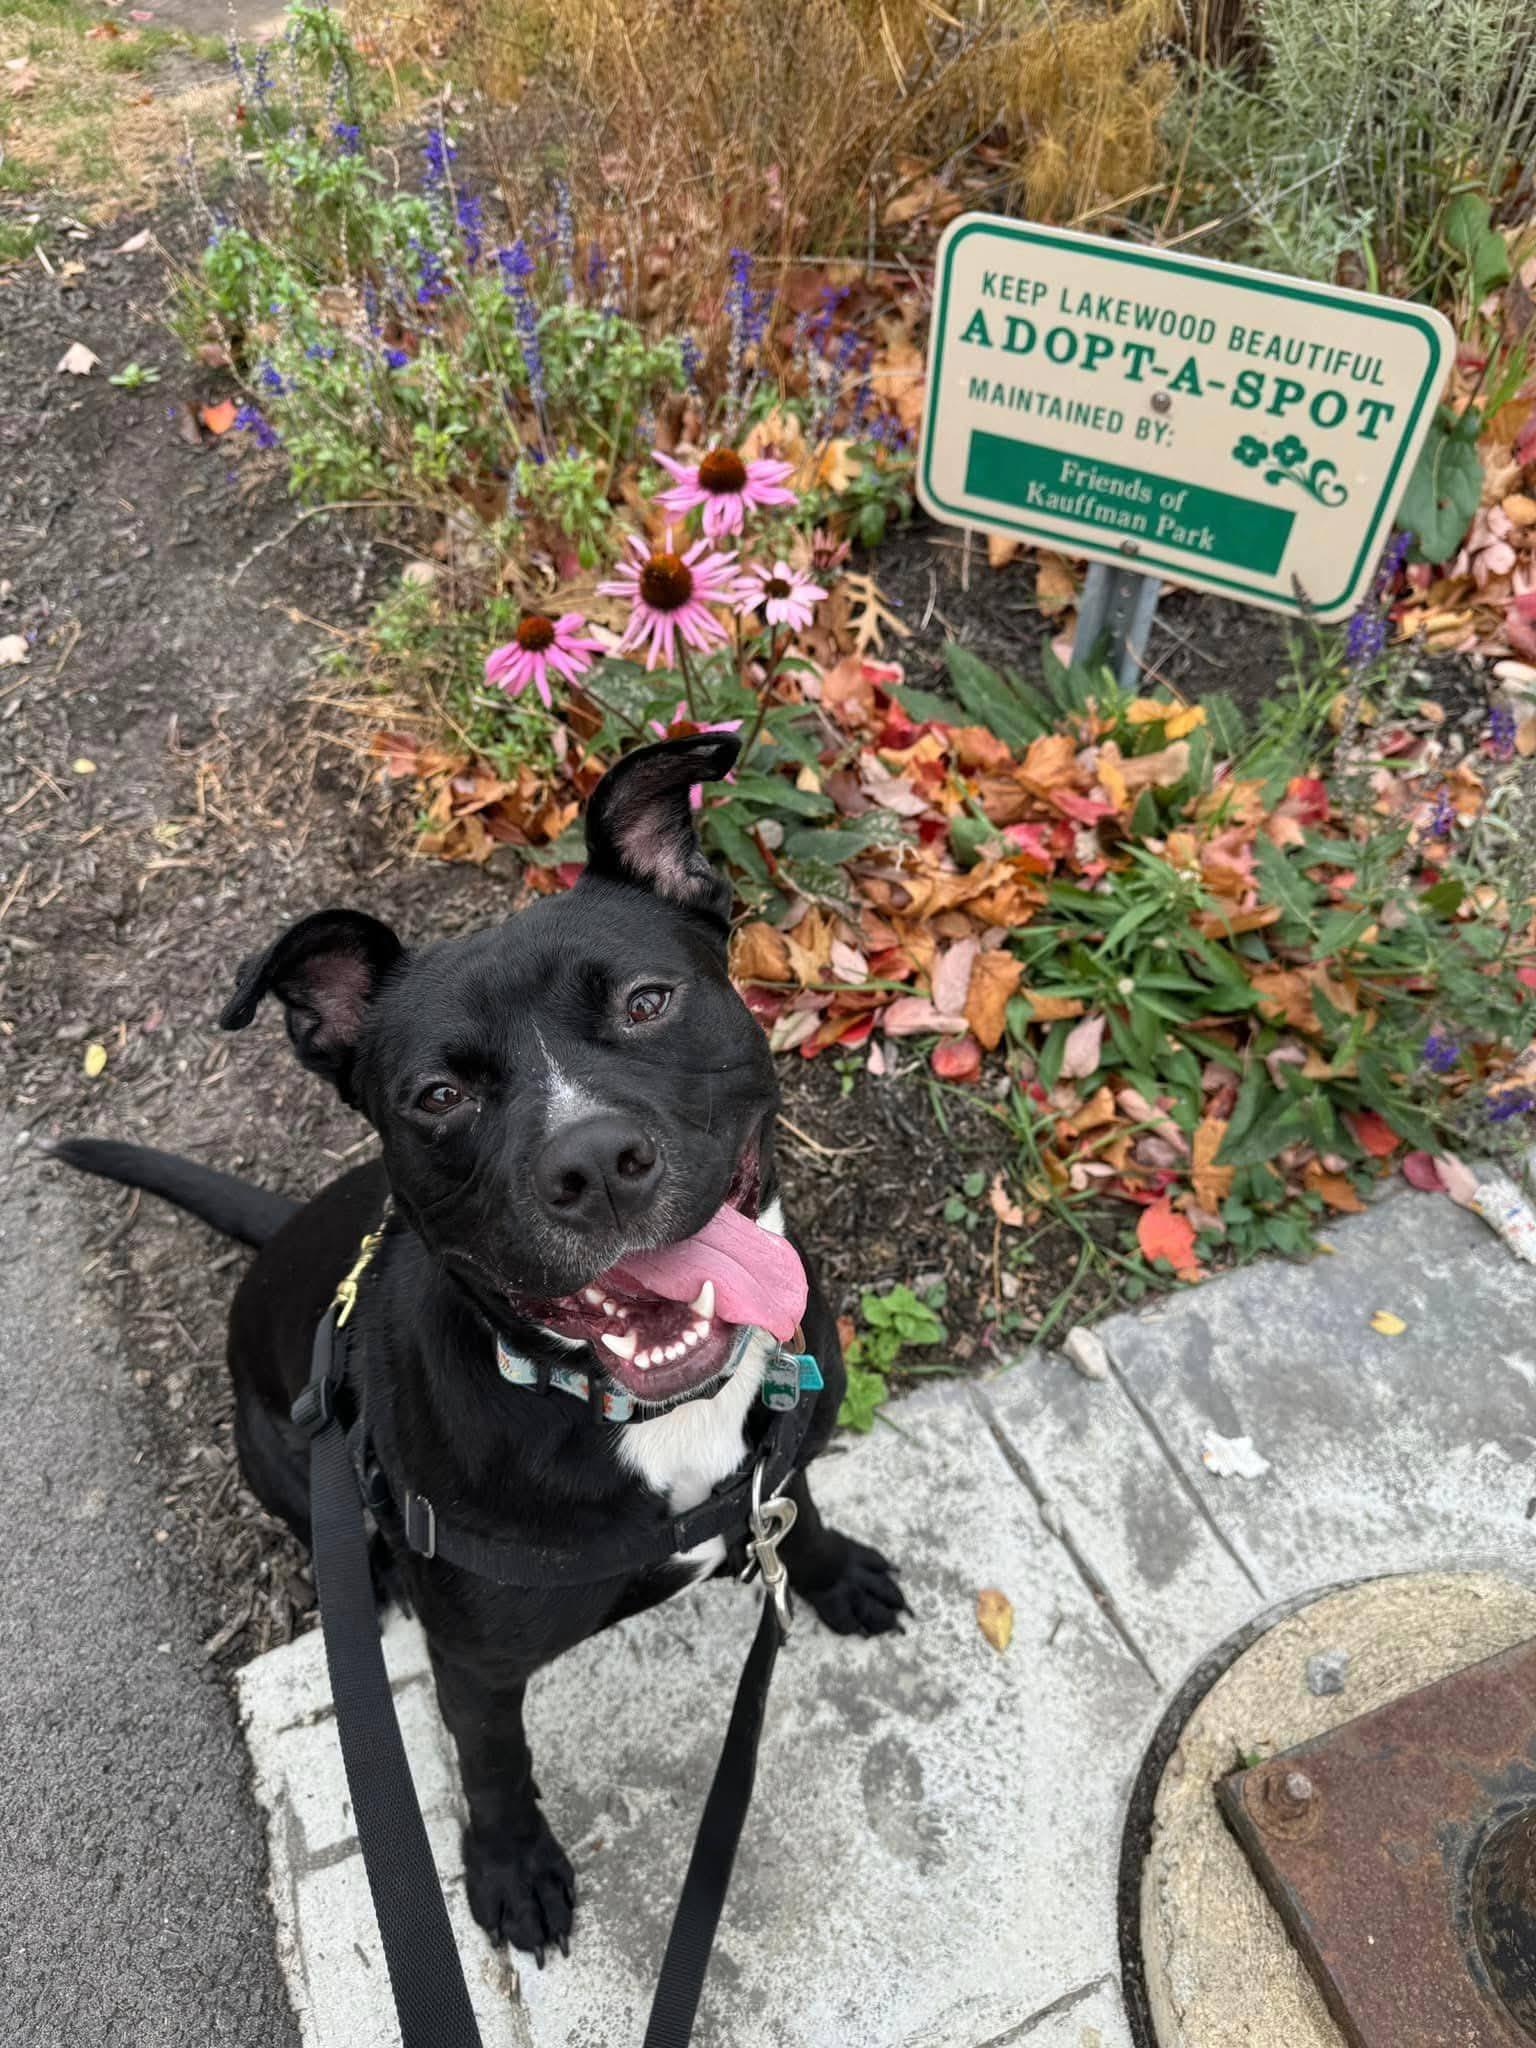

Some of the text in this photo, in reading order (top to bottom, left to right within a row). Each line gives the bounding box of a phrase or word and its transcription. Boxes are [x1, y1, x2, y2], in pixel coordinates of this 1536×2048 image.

[981, 271, 1386, 386] KEEP LAKEWOOD BEAUTIFUL
[959, 308, 1395, 441] ADOPT-A-SPOT
[968, 378, 1175, 448] MAINTAINED BY:
[1026, 482, 1215, 552] Kauffman Park
[1058, 460, 1189, 513] Friends of
